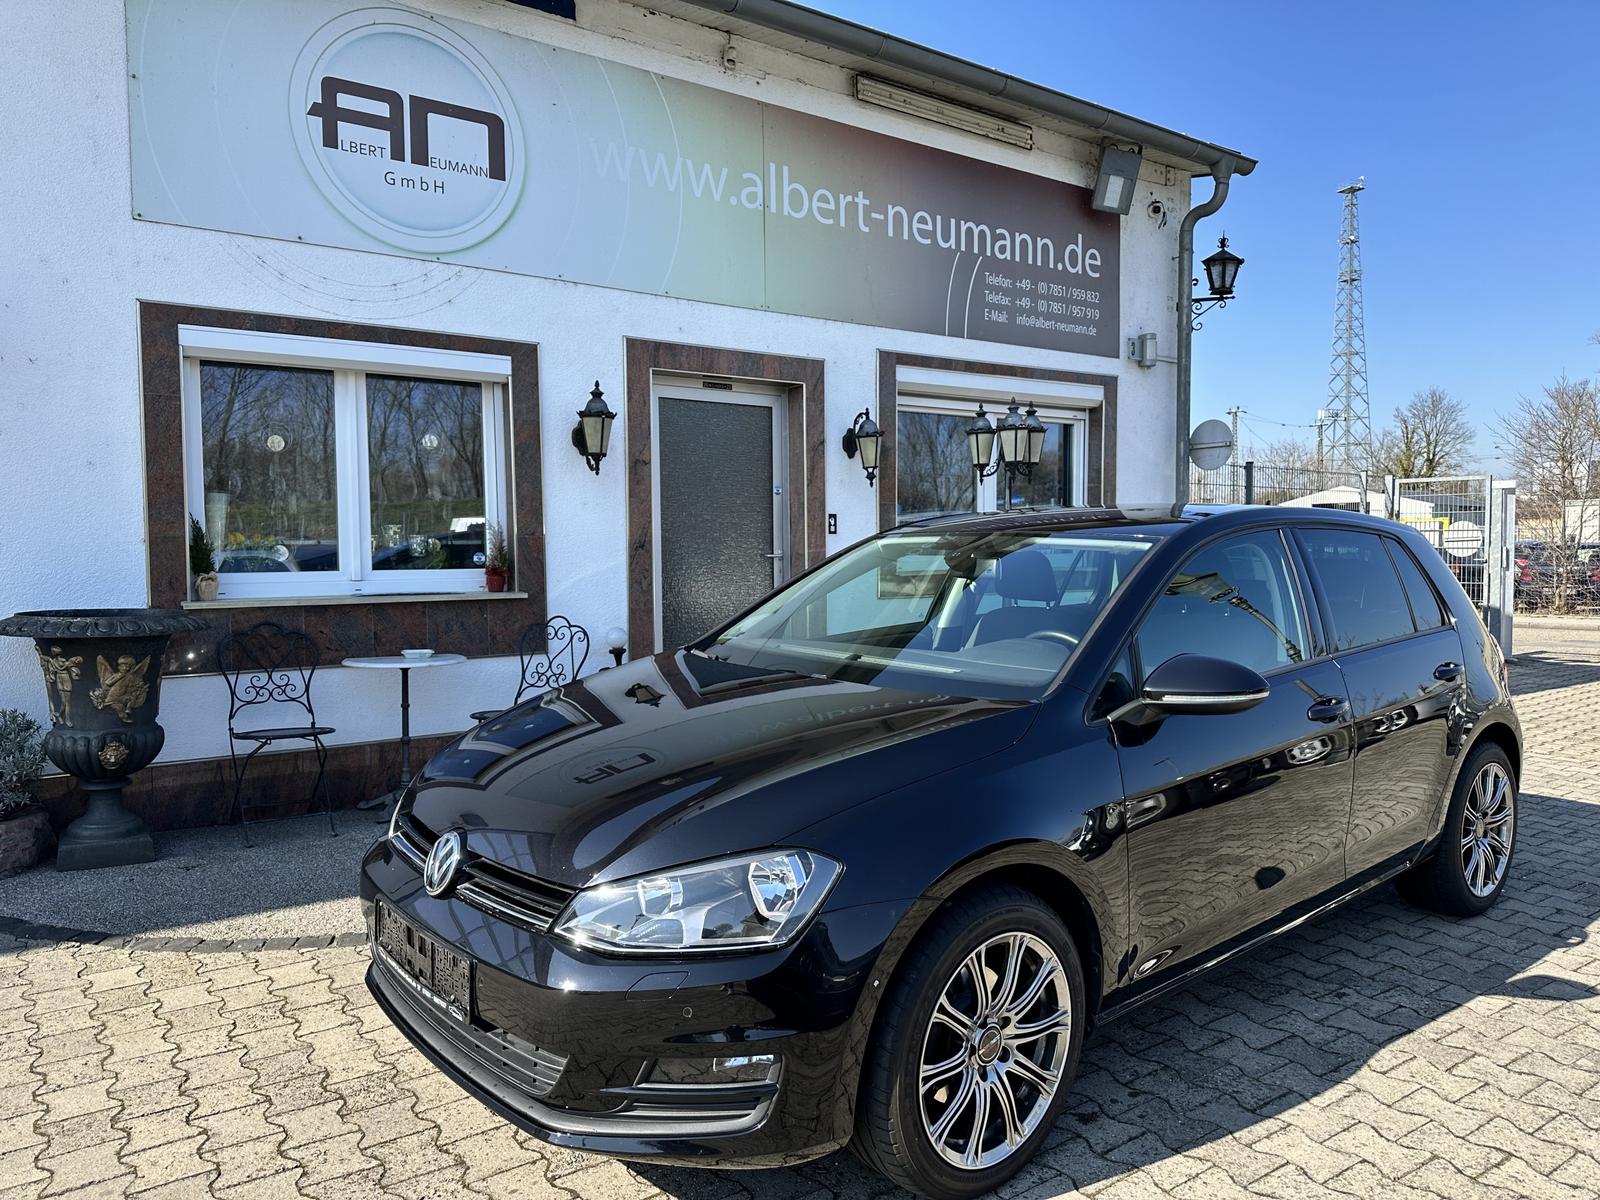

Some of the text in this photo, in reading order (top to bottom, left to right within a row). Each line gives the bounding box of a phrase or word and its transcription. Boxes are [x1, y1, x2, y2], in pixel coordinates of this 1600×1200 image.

[589, 137, 1102, 278] www.albert-neumann.de
[984, 272, 1013, 289] Telefon:
[1037, 280, 1048, 295] (0)
[1048, 283, 1066, 297] 7851
[984, 290, 1012, 306] Telefax:
[1037, 299, 1048, 313] (0)
[1048, 301, 1066, 315] 7851
[984, 308, 1097, 336] E-Mail: info@albert-neumann.de
